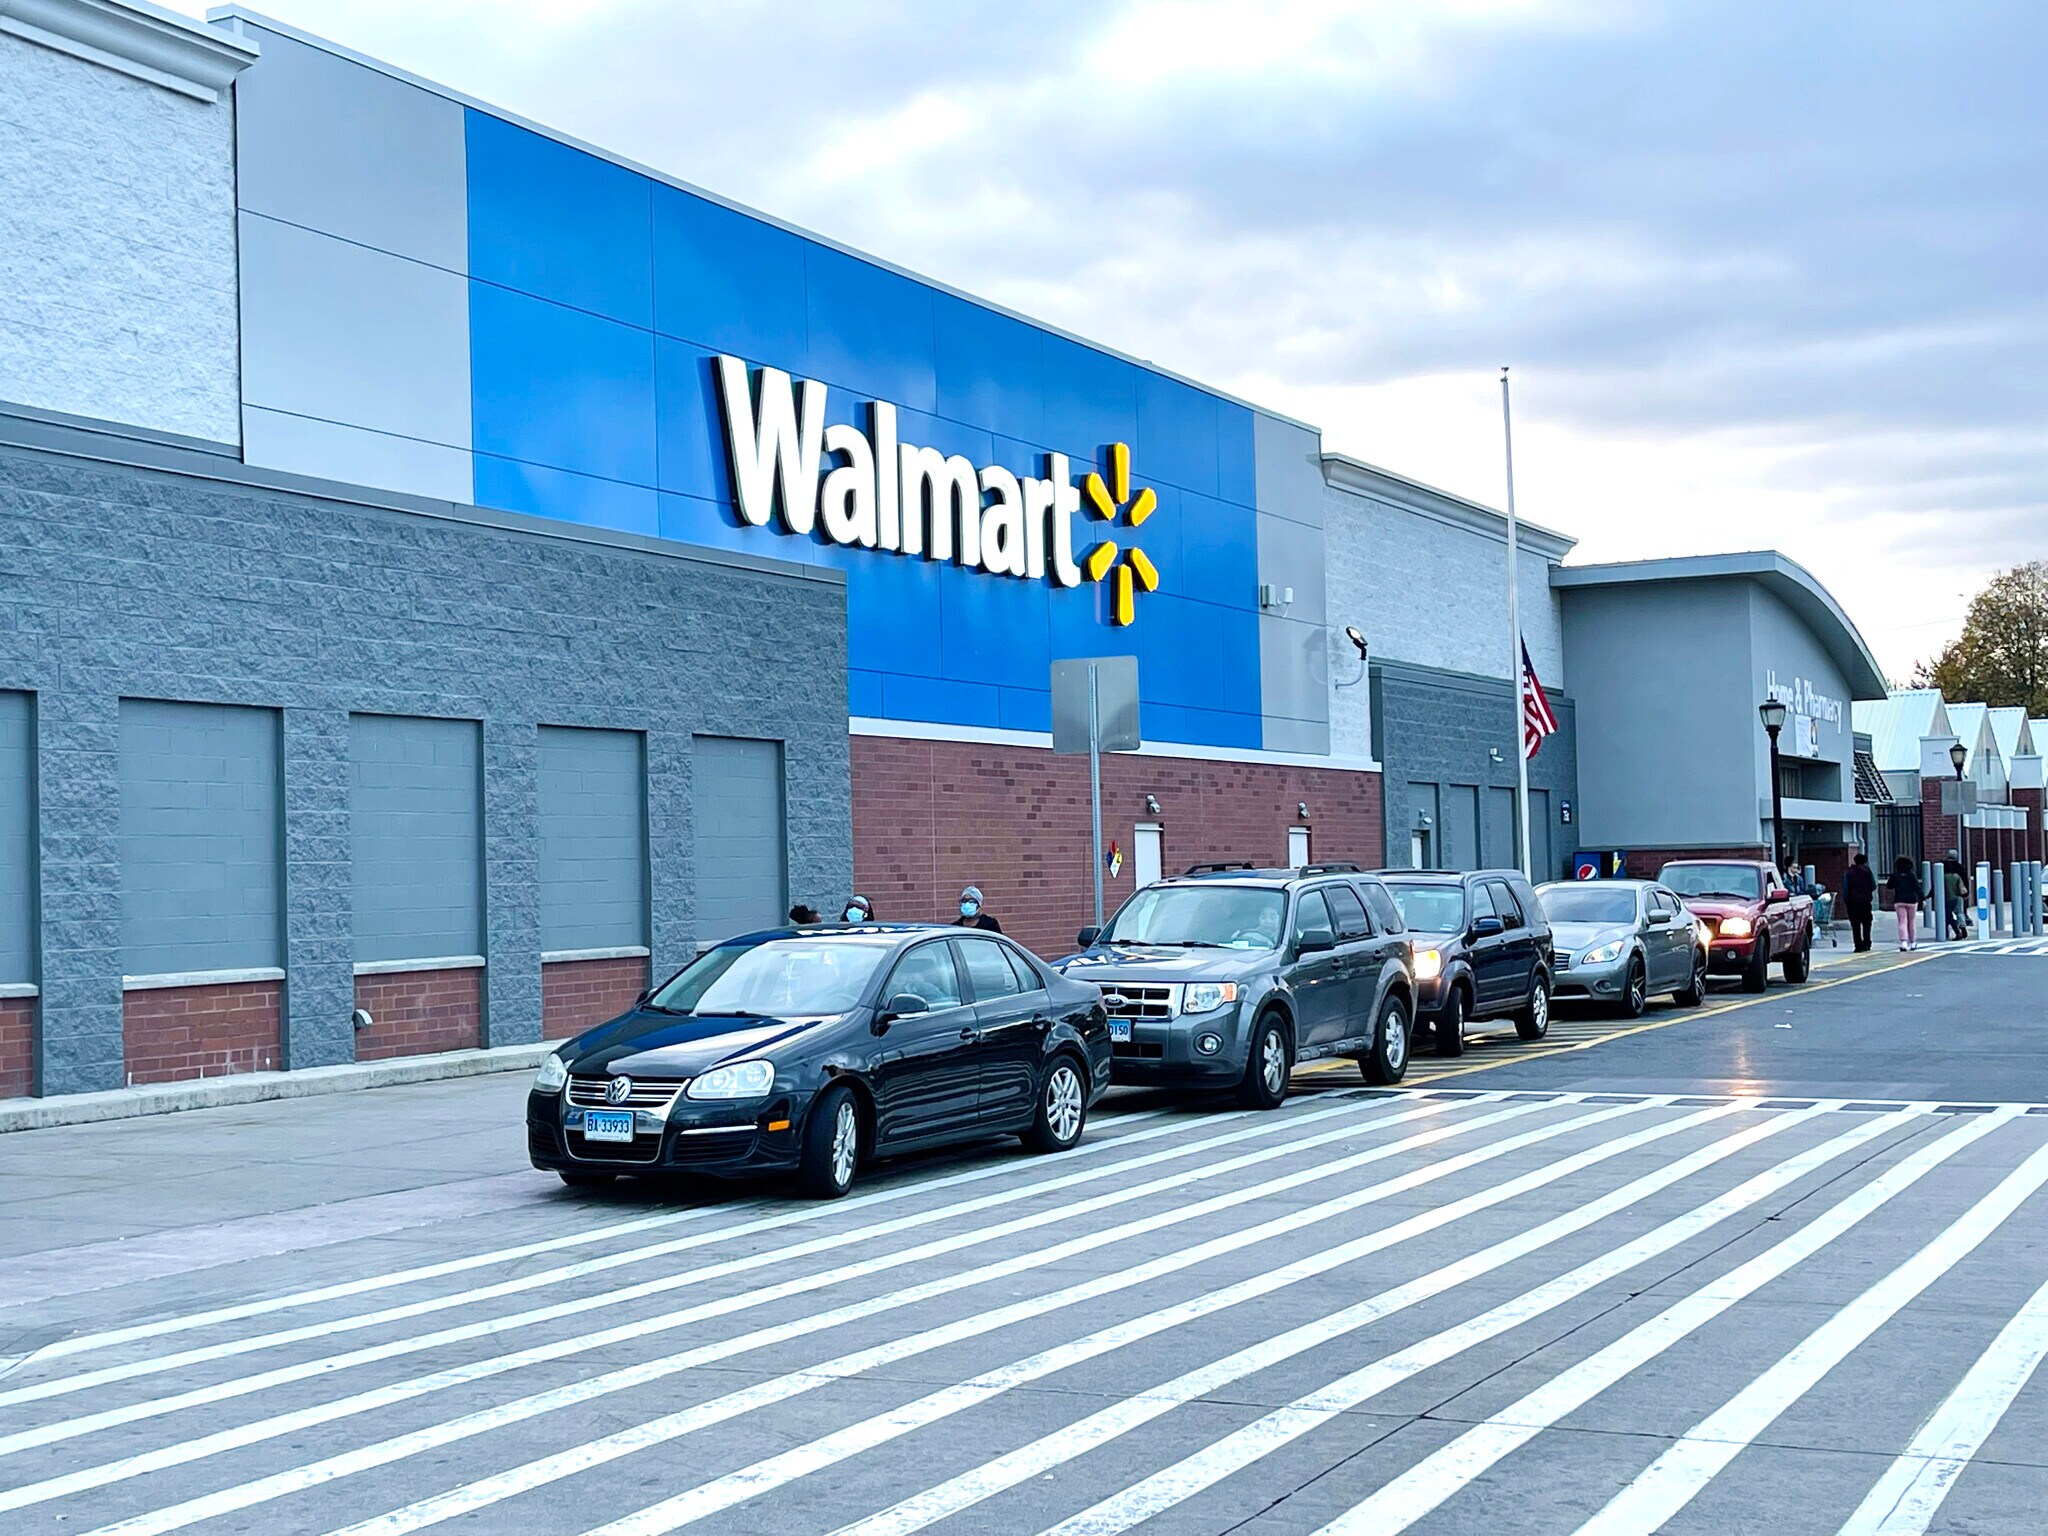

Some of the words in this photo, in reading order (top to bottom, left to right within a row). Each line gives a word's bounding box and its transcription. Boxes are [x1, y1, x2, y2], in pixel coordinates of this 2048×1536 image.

[715, 354, 1083, 588] Walmart
[1767, 669, 1794, 713] Home
[1794, 677, 1803, 714] &
[1803, 680, 1843, 734] Pharmacy
